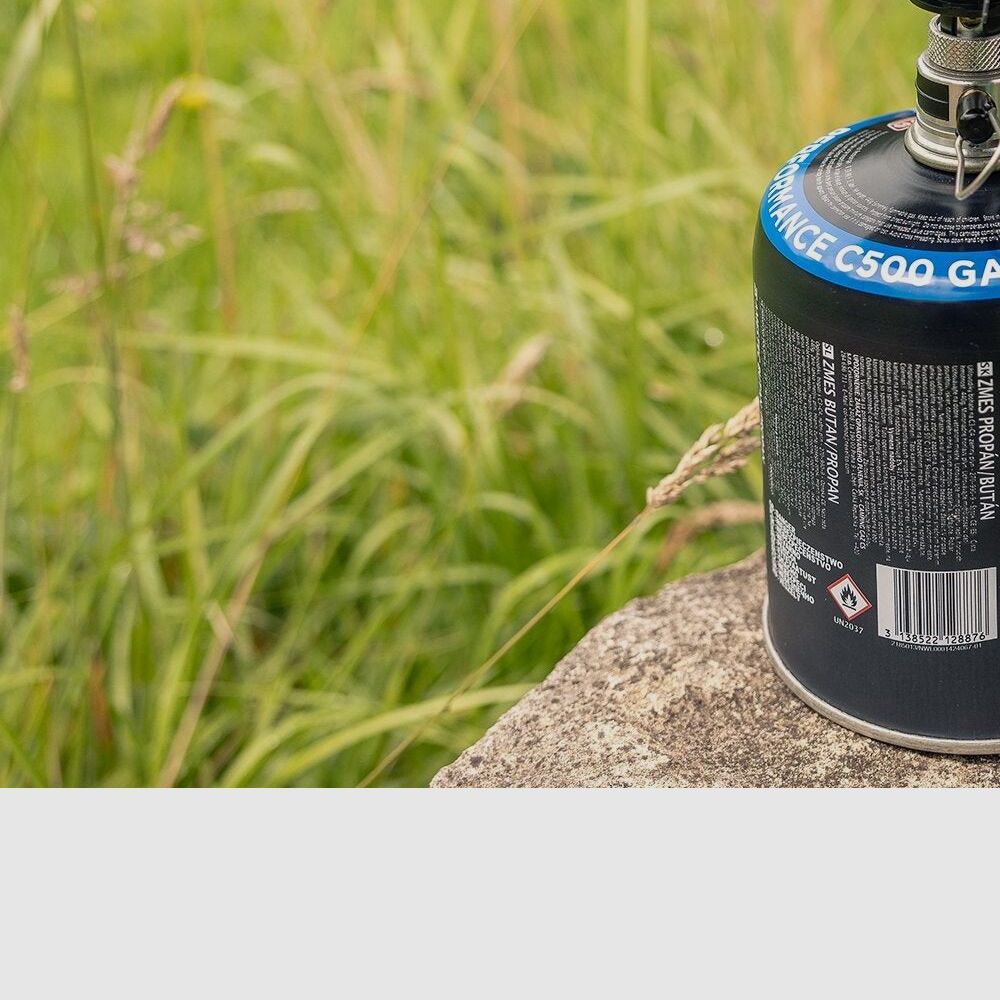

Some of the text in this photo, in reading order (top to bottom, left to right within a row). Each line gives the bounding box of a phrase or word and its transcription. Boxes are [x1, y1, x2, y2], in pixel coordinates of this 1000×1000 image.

[835, 245, 934, 287] C500
[823, 359, 837, 397] ZMES
[824, 399, 840, 505] BUTAN/PROPAN
[977, 361, 999, 521] SK ZMES PROPÁN/BUTÁN
[833, 615, 864, 634] UN2037
[885, 628, 986, 645] 3 138522 128876
